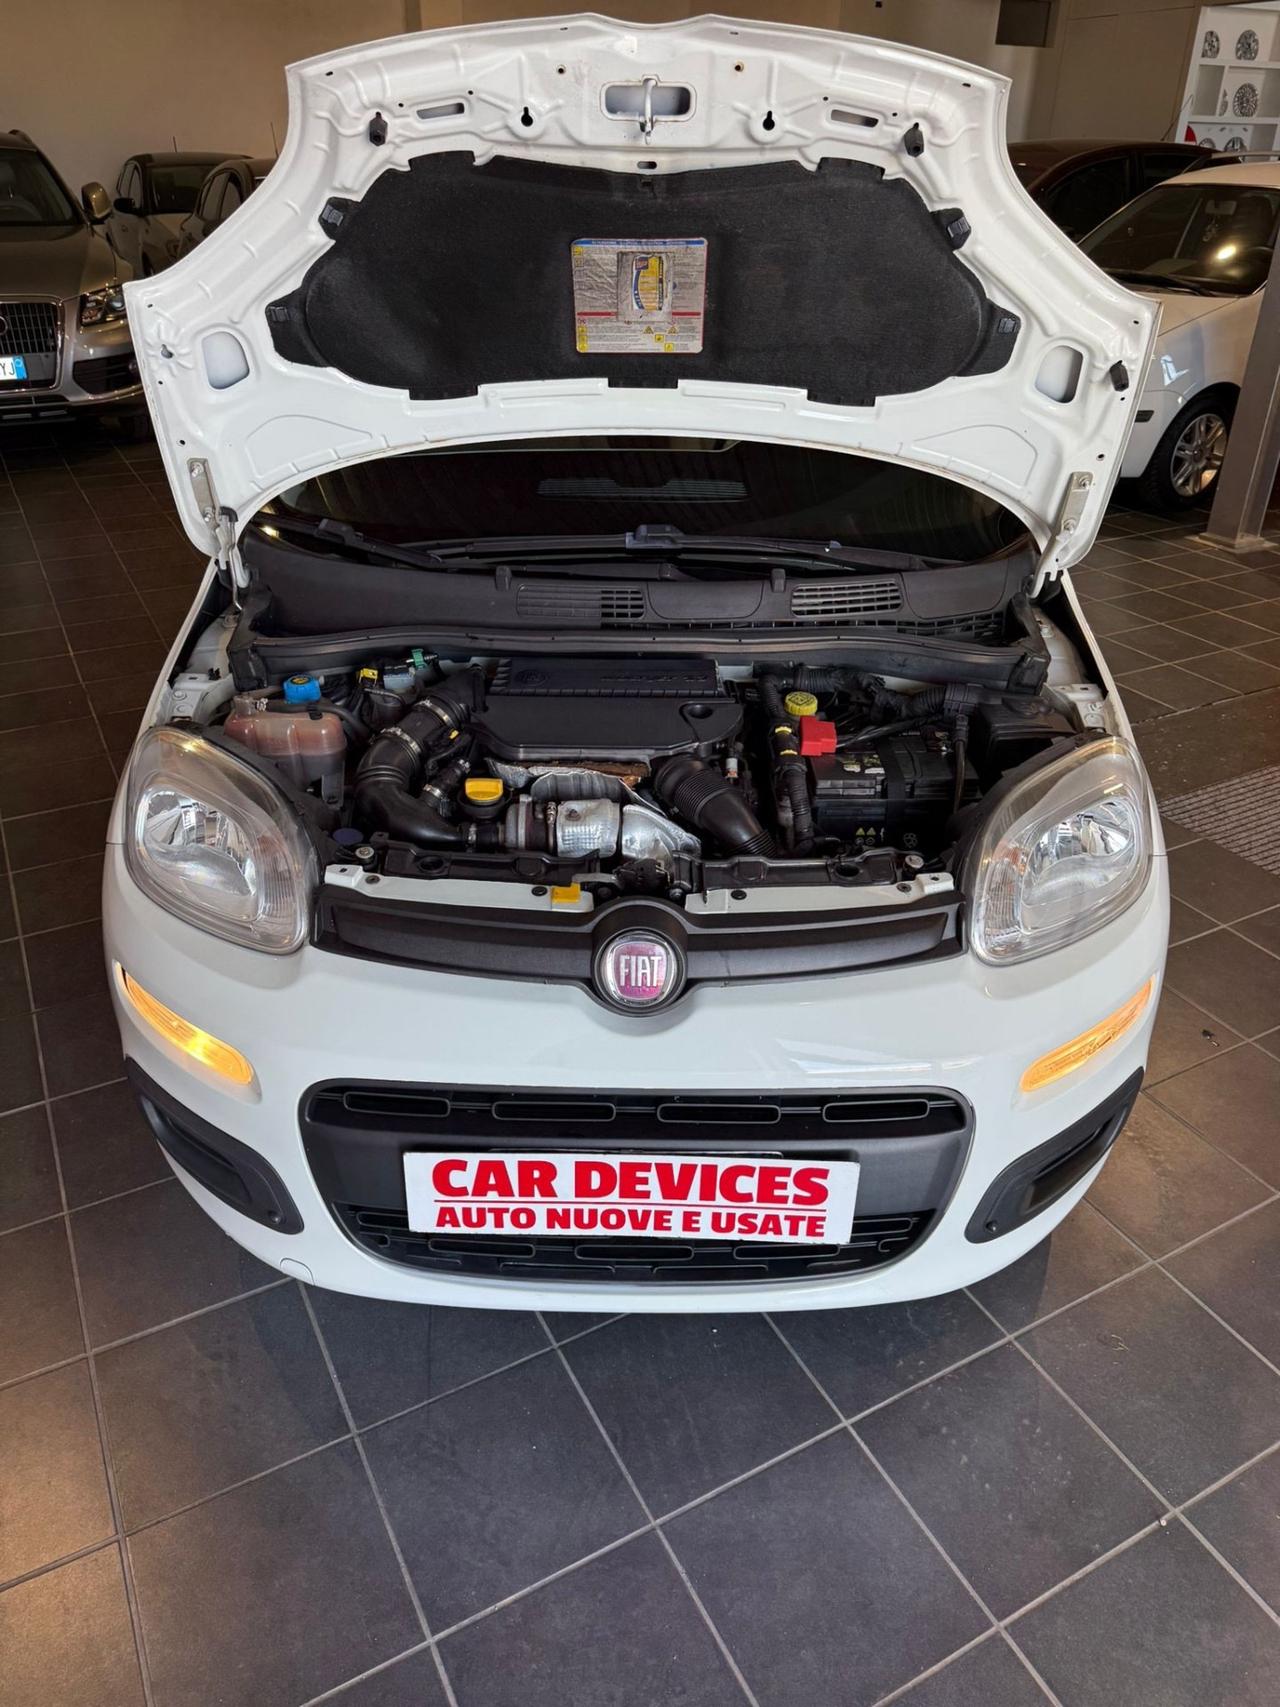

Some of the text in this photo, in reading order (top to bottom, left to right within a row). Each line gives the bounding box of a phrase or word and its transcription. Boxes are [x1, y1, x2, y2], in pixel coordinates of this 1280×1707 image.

[619, 954, 662, 987] FIAT
[432, 1158, 829, 1207] CAR DEVICES
[436, 1206, 826, 1238] AUTO NUOVE E USATE
